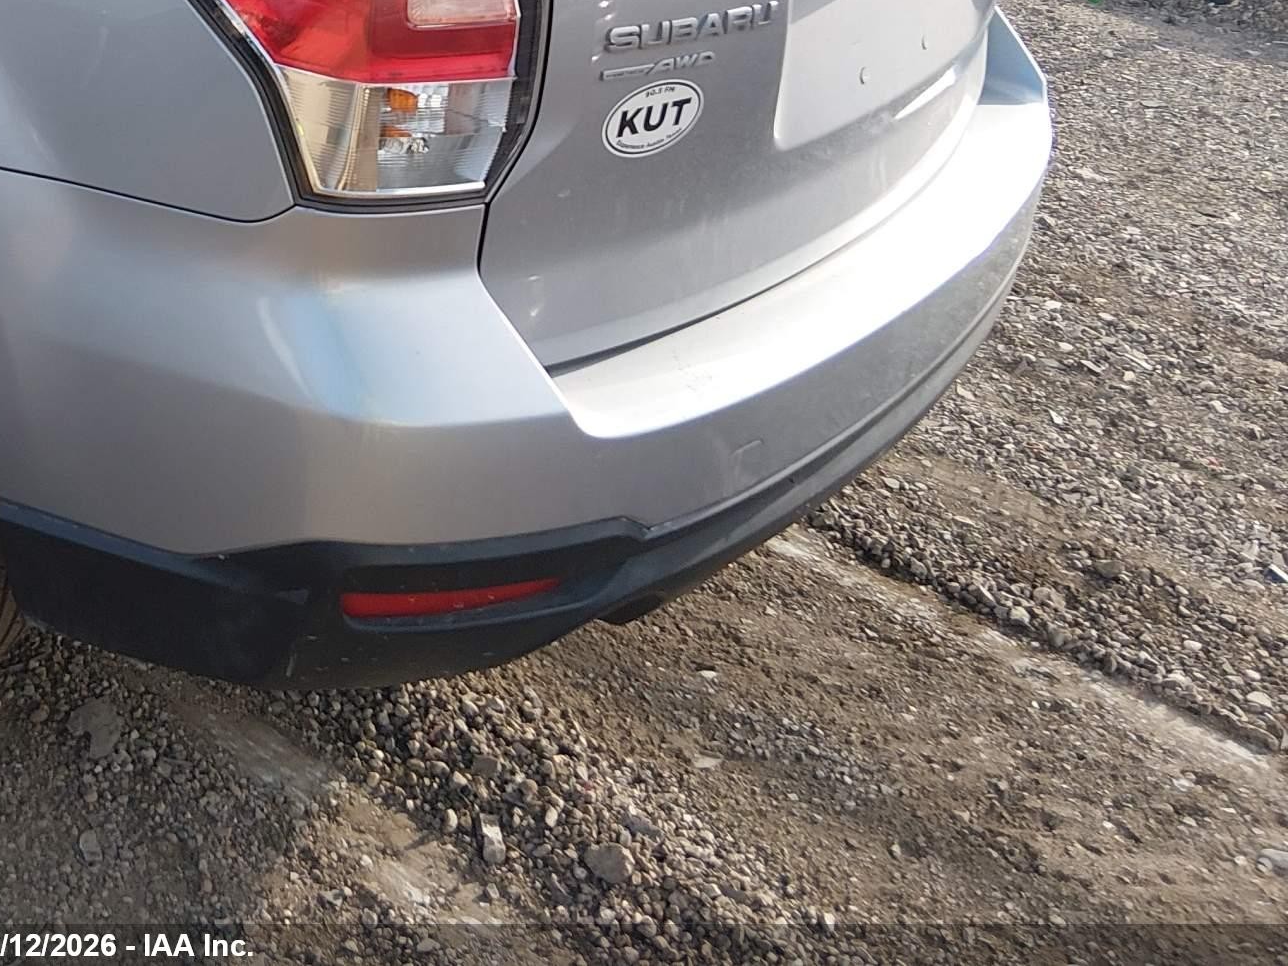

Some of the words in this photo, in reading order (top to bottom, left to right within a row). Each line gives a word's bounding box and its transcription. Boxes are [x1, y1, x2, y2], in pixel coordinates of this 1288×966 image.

[604, 0, 779, 52] SUBARU
[648, 51, 715, 75] AWD
[616, 97, 692, 138] KUT
